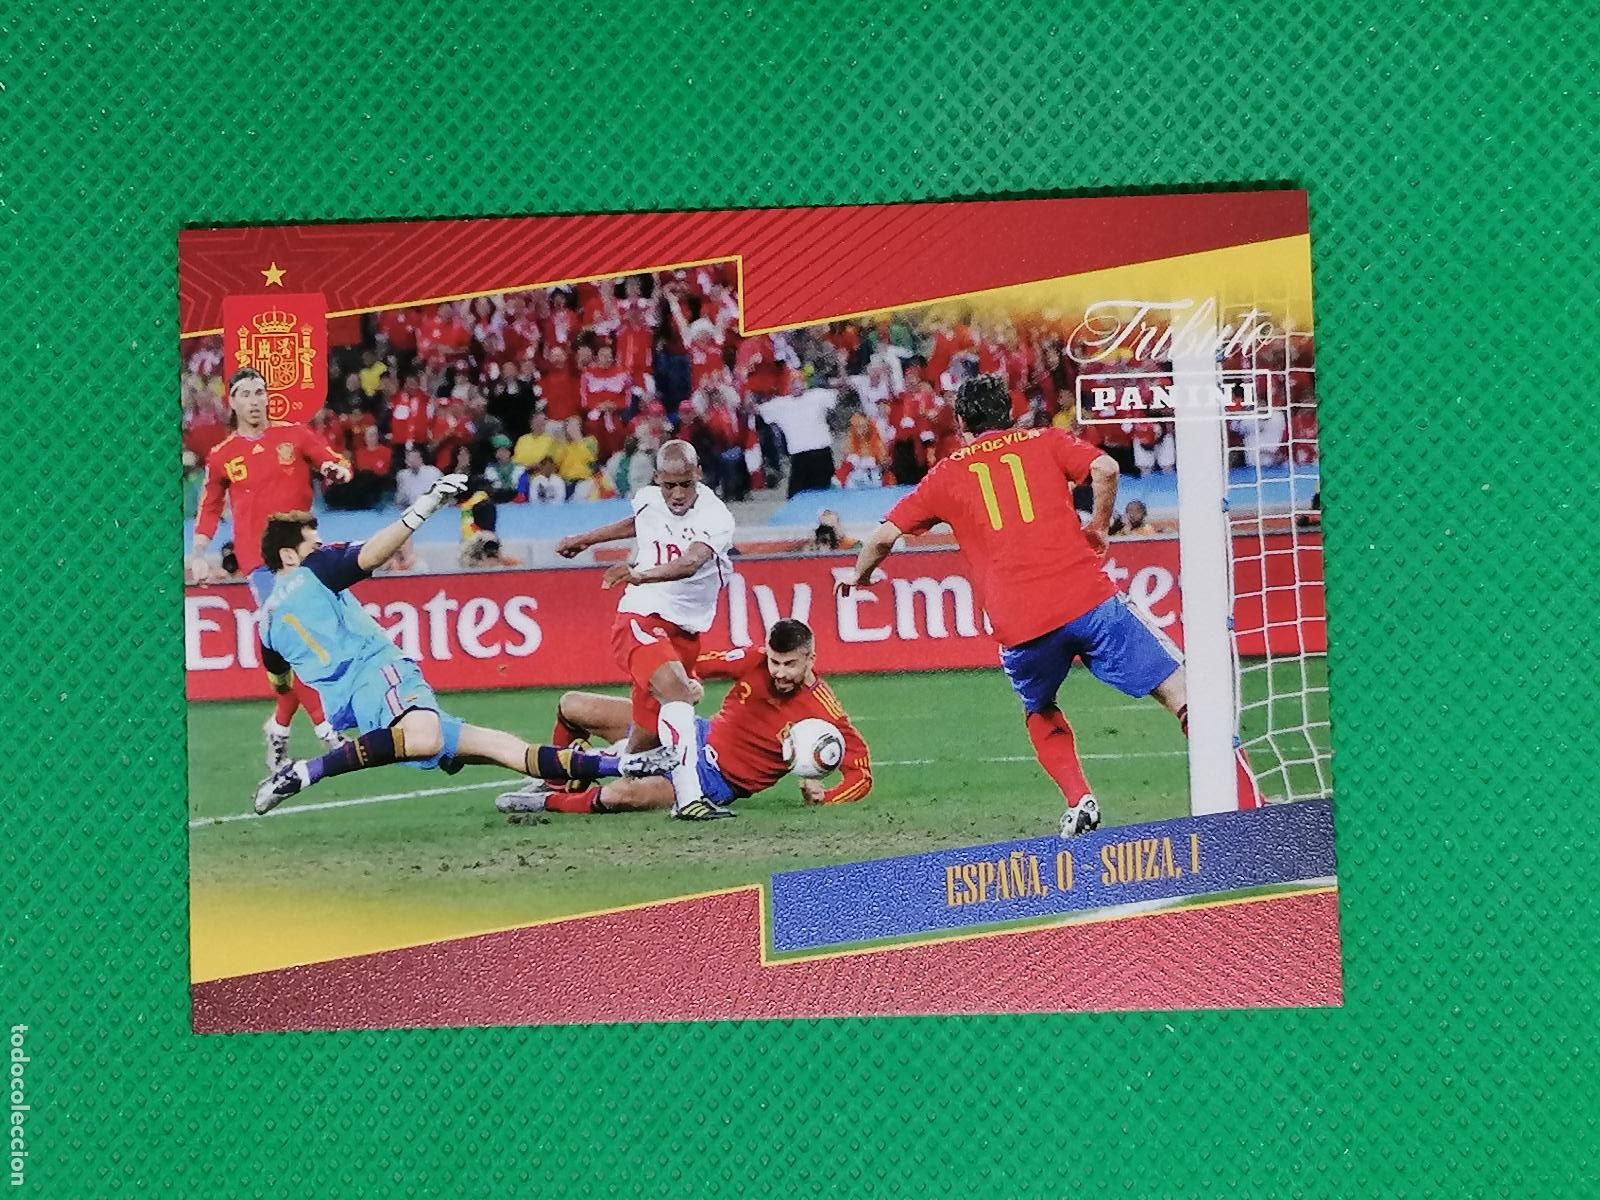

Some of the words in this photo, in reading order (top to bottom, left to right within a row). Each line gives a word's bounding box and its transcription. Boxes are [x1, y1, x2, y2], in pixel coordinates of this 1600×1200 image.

[1066, 297, 1273, 364] Tributo
[1091, 382, 1255, 411] PANINI
[224, 456, 248, 483] 15
[967, 453, 1035, 531] 11
[945, 851, 1048, 907] ESPAÑA,
[1100, 836, 1182, 886] SUIZA,
